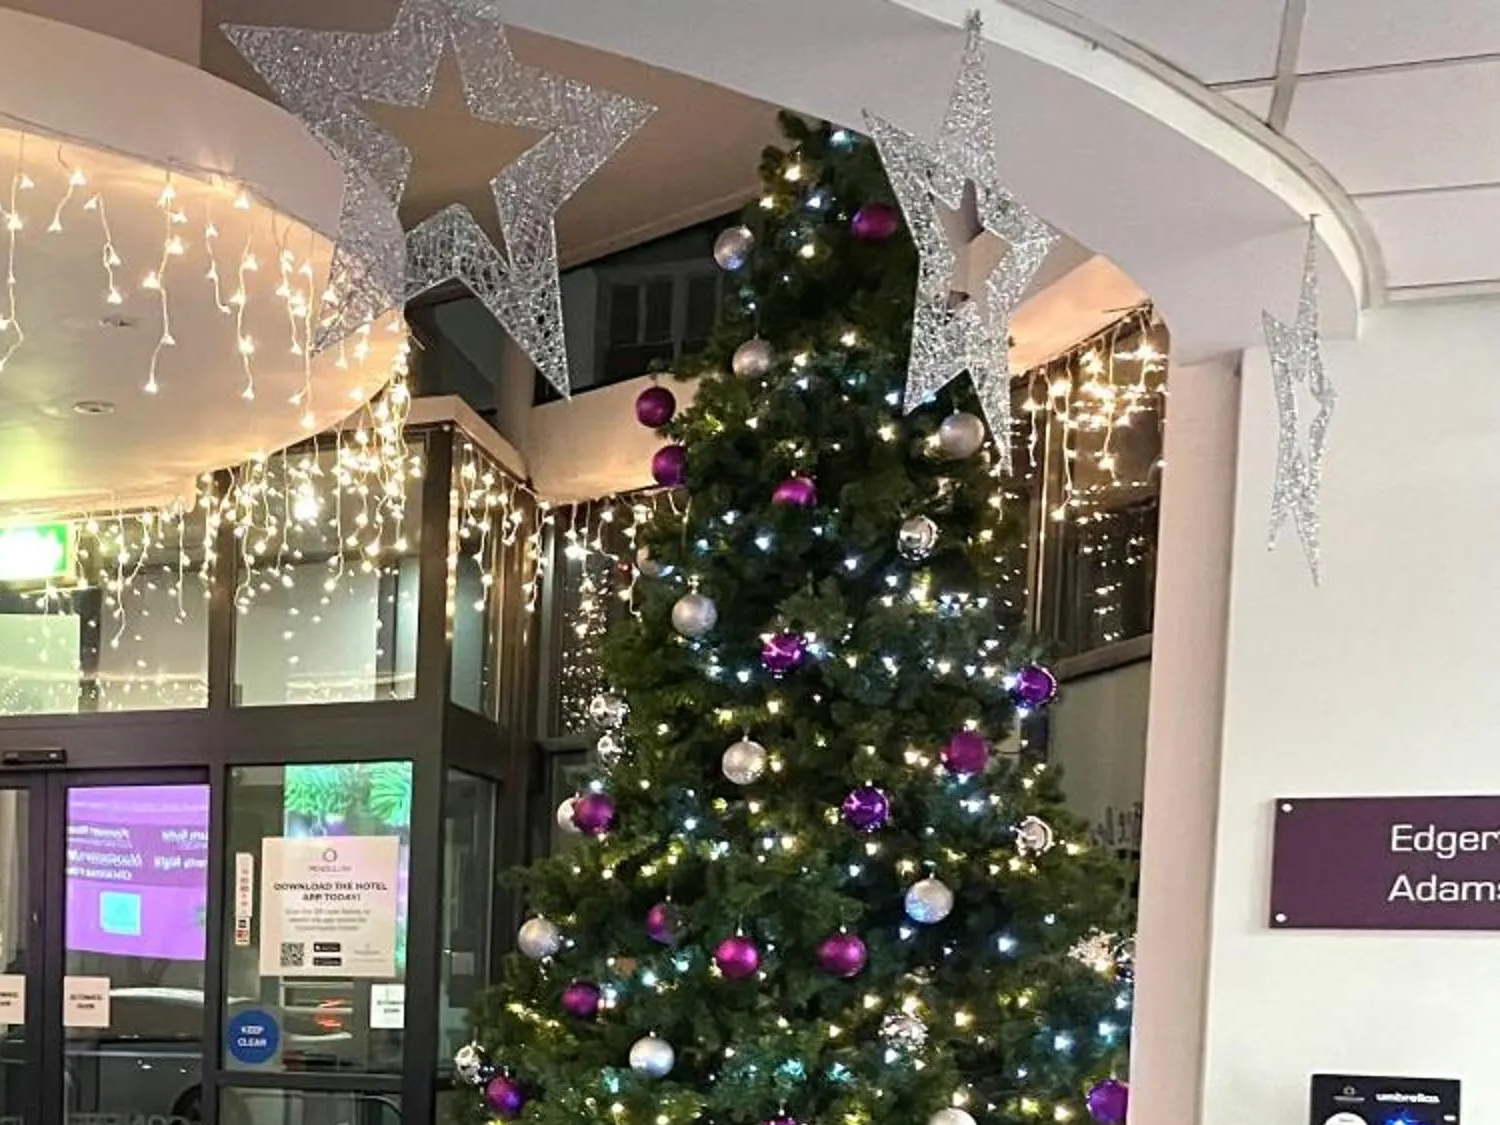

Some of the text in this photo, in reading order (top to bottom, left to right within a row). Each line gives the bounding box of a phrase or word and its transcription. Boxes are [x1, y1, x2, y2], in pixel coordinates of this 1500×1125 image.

[1391, 823, 1500, 859] Edger
[273, 881, 388, 890] DOWNLOAD THE HOTEL
[1388, 874, 1500, 902] Adam
[302, 893, 361, 902] APP TODAY!
[241, 1025, 265, 1035] KEEP
[237, 1037, 267, 1047] CLEAR
